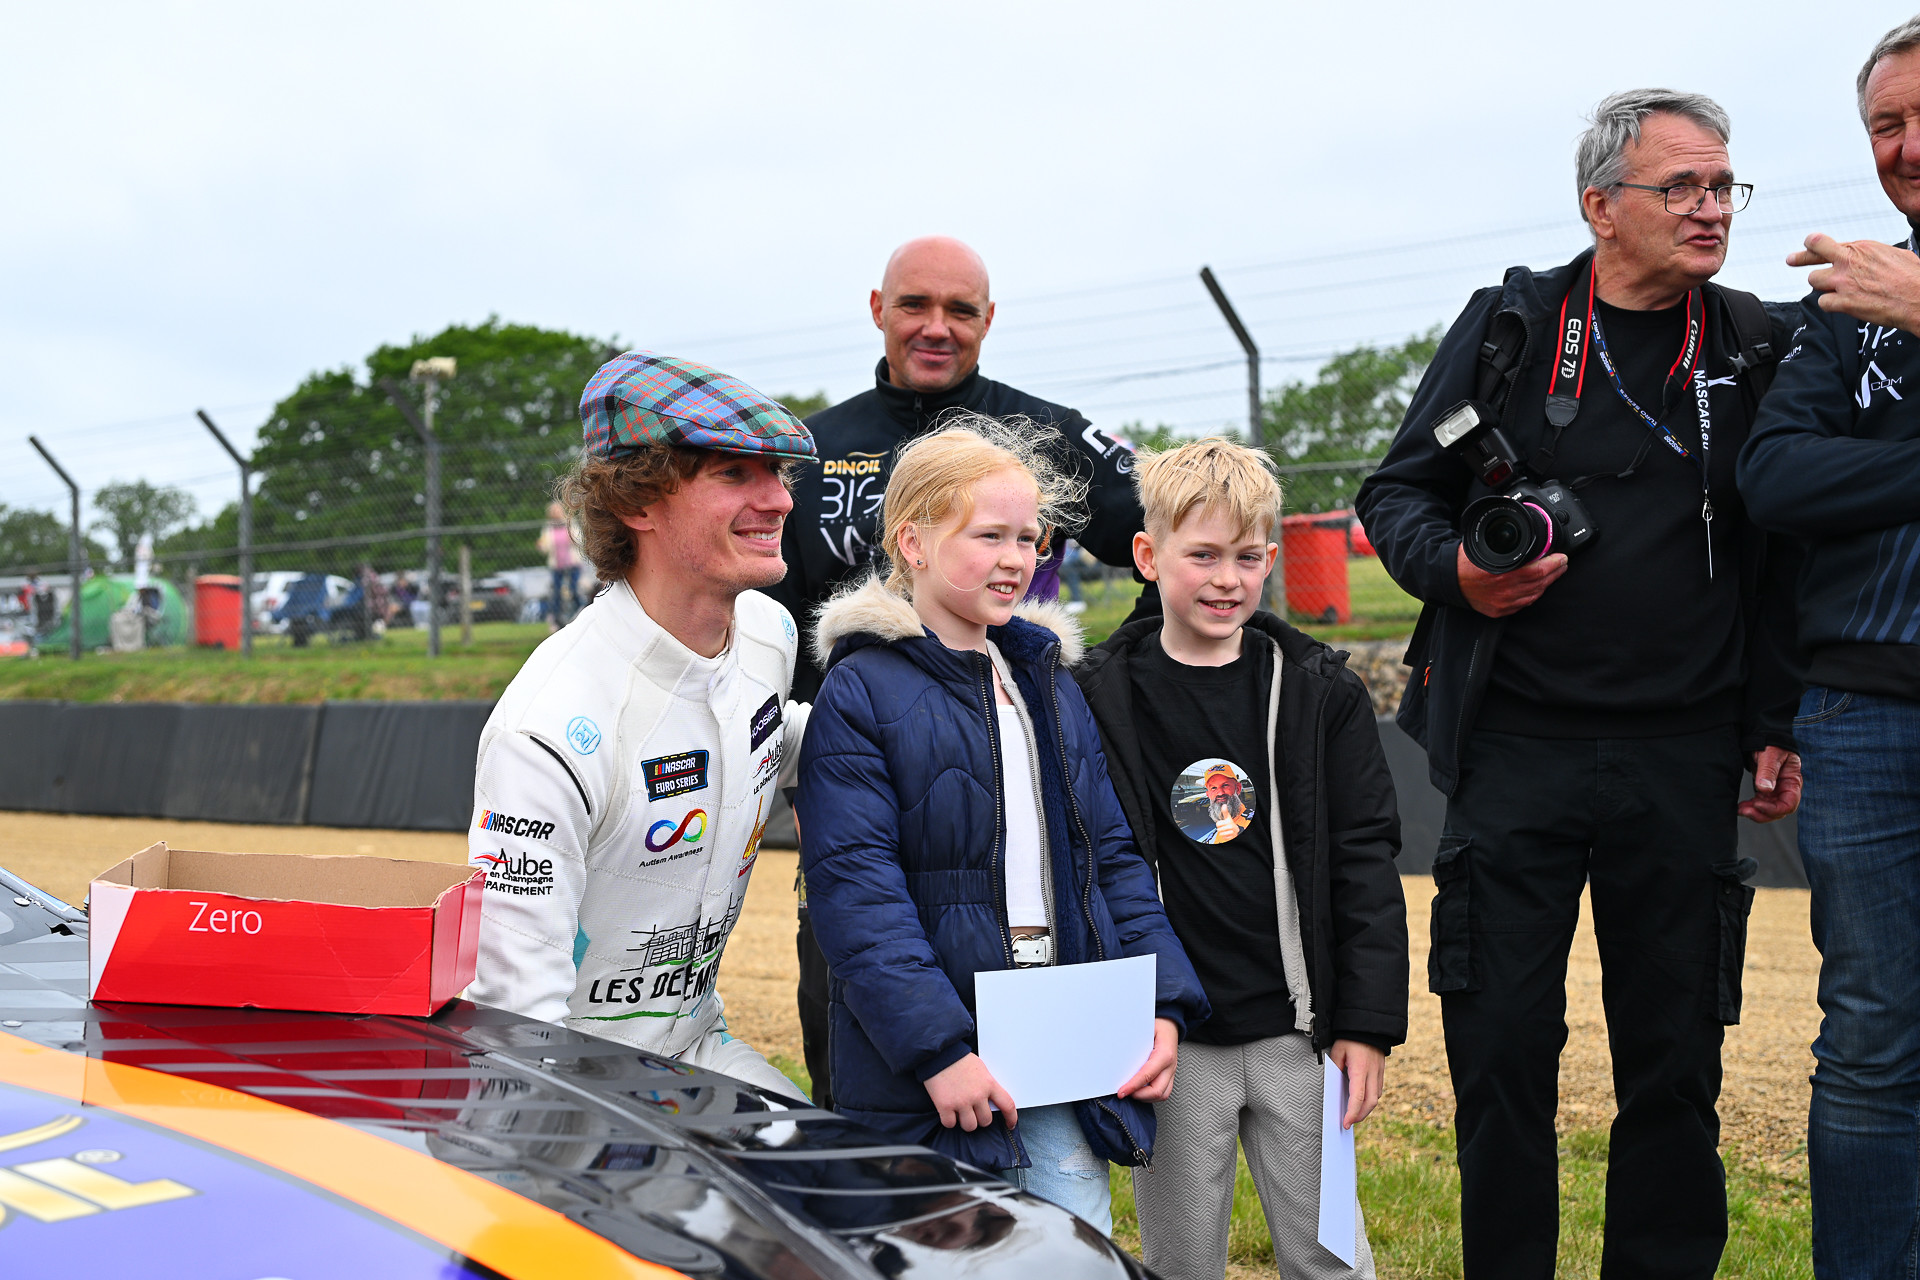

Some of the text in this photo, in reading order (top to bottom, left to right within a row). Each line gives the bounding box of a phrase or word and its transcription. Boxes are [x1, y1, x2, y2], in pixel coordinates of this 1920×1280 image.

[1561, 318, 1582, 379] EOS 7D
[1682, 319, 1699, 370] Canon
[1693, 370, 1711, 450] NASCAR.eu
[823, 459, 881, 476] DINOIL
[1483, 455, 1498, 467] Canon
[665, 757, 696, 774] NASCAR
[655, 774, 699, 794] EURO SERIES
[490, 811, 555, 840] NASCAR
[492, 848, 553, 876] Aube
[638, 846, 703, 868] Autism Awareness
[489, 871, 554, 886] en Champagne
[188, 901, 263, 935] Zero
[589, 976, 644, 1004] LES
